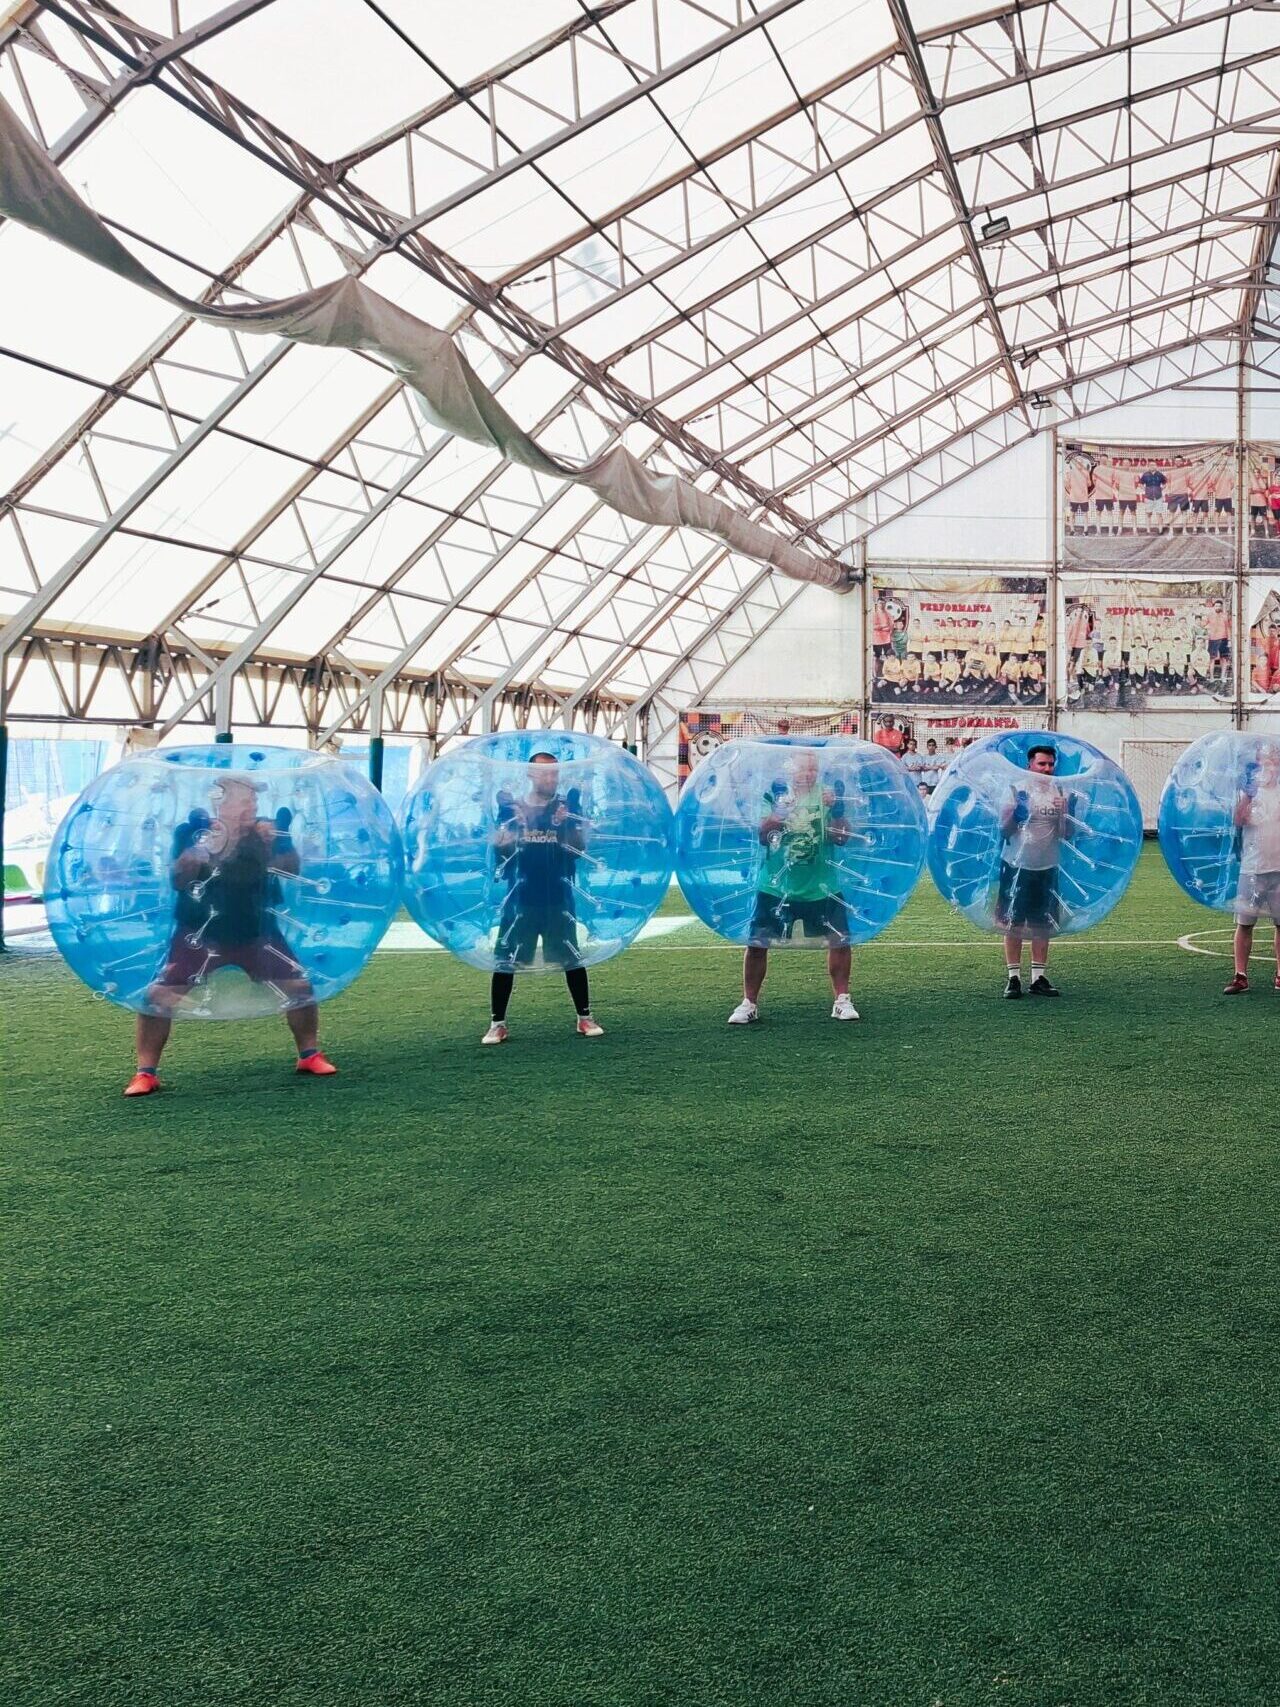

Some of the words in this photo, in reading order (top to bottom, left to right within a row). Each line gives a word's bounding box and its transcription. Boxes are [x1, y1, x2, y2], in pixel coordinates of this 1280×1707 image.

[1112, 457, 1193, 468] PERFOMATA
[920, 602, 993, 613] PERFORMANTA
[927, 717, 1020, 729] PERFORMANTA
